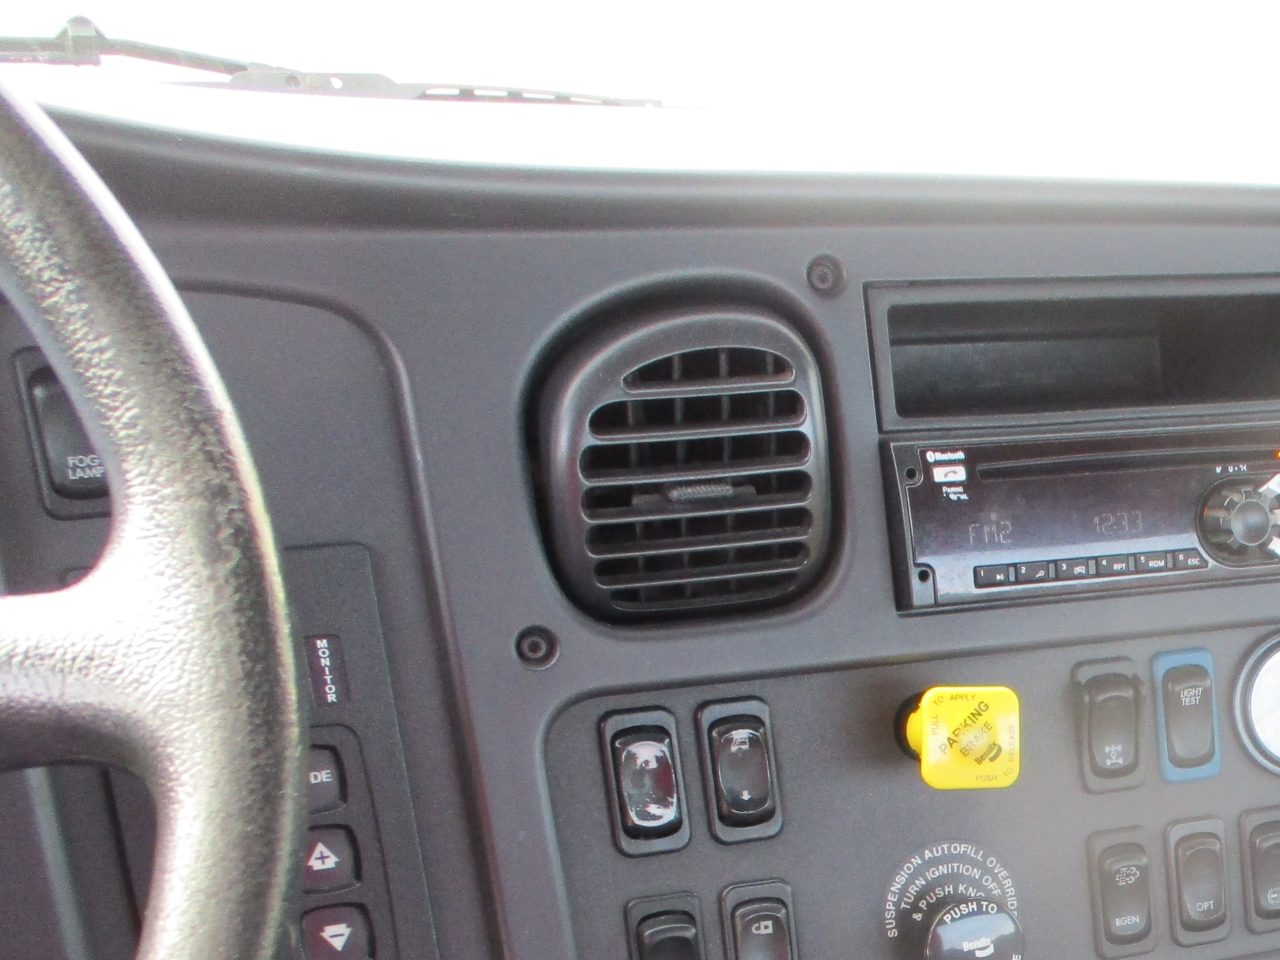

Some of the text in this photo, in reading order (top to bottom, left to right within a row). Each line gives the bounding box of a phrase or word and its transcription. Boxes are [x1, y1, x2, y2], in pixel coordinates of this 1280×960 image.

[67, 454, 100, 467] FOG
[1113, 563, 1127, 571] RPT
[316, 639, 337, 703] MONITOR
[933, 695, 944, 706] TO
[950, 693, 976, 702] APPLY
[1180, 687, 1203, 698] LIGHT
[1182, 696, 1201, 706] TEST
[938, 700, 990, 755] PARKING
[960, 721, 993, 757] BRAKE
[974, 740, 998, 765] Bendix
[309, 769, 332, 784] DE
[975, 774, 998, 782] PUSH
[1003, 767, 1013, 777] TO
[885, 856, 922, 938] SUSPENSION
[924, 843, 984, 861] AUTOFILL
[900, 863, 1002, 910] TURN IGNITION OFF
[912, 883, 985, 922] & PUSH KN
[1196, 900, 1214, 912] OPT
[943, 901, 998, 924] PUSH TO
[1115, 915, 1140, 927] RGEN
[962, 937, 991, 952] Bendix
